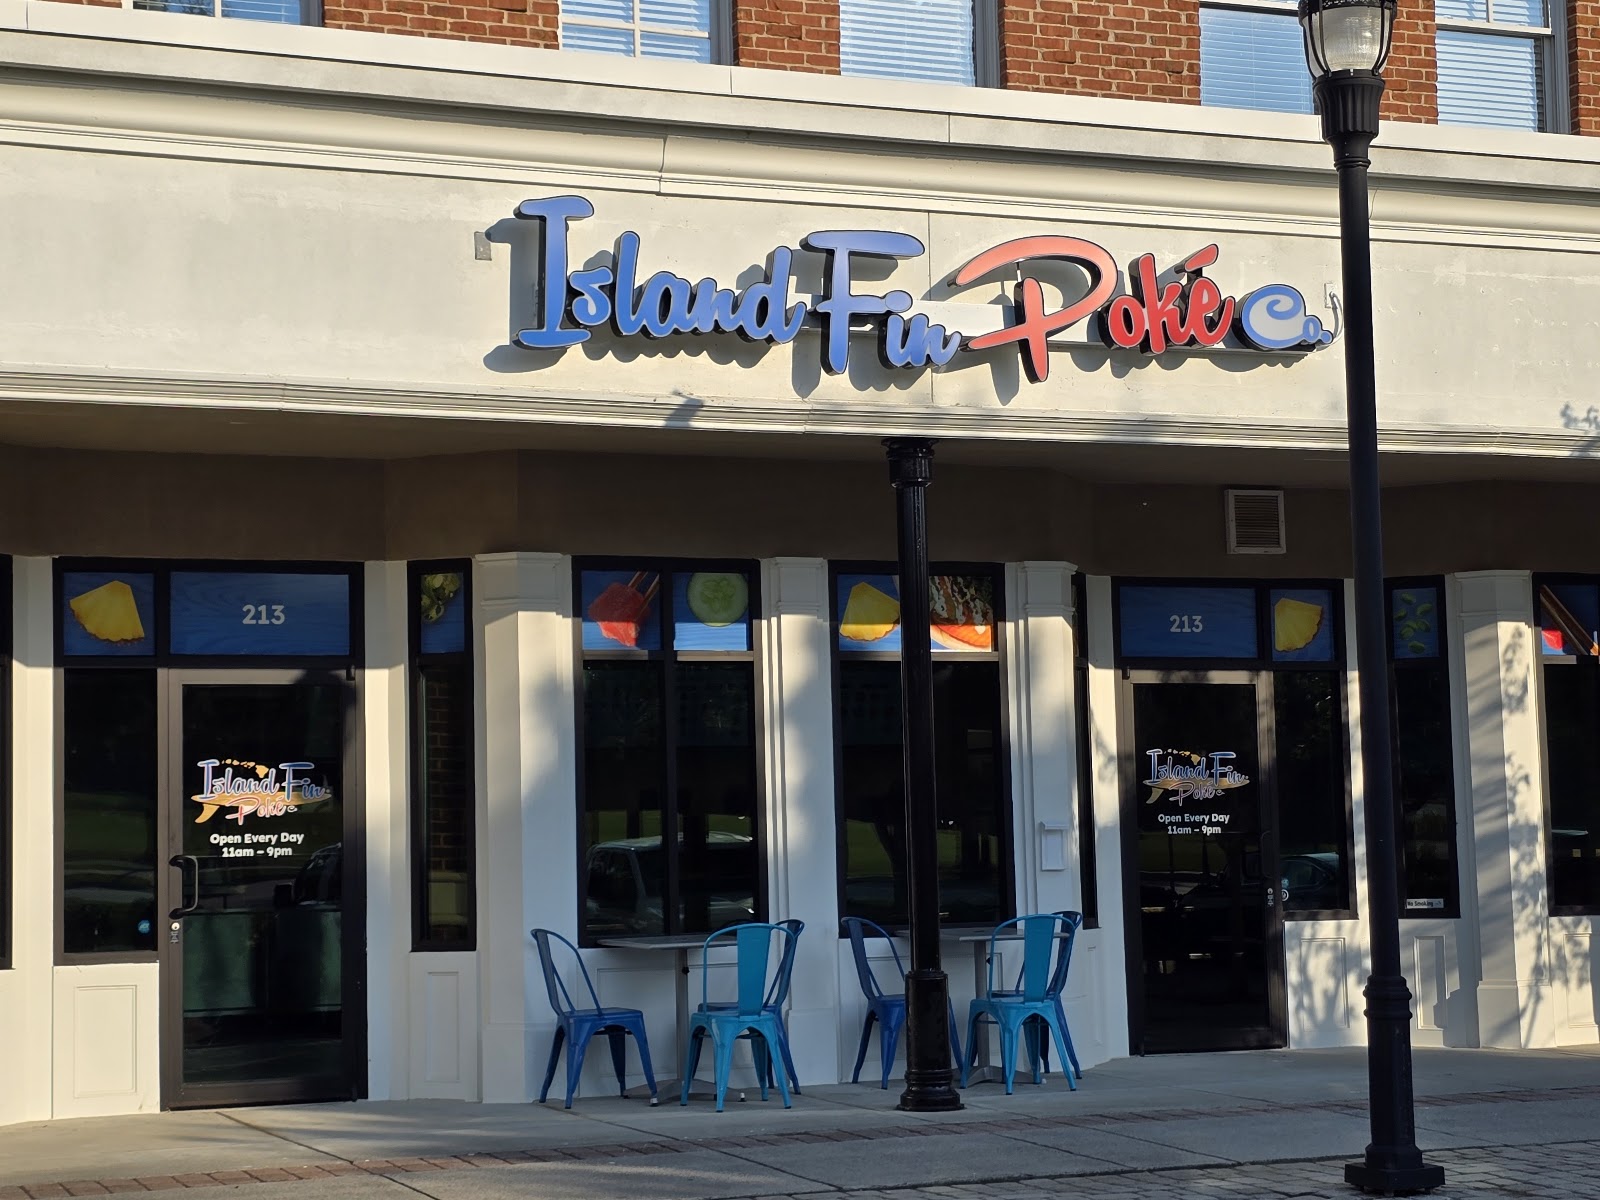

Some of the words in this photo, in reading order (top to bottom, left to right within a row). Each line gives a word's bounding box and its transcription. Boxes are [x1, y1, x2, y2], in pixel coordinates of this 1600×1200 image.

[512, 195, 805, 347] Island
[800, 230, 962, 375] Fin
[947, 235, 1235, 383] Poké
[1235, 283, 1335, 351] Co.
[242, 604, 286, 625] 213
[1169, 614, 1203, 633] 213
[1146, 749, 1209, 784] Island
[1208, 752, 1246, 786] Fin
[197, 759, 280, 800] Island
[279, 762, 325, 801] Fin
[1168, 781, 1216, 806] Poké
[225, 796, 286, 825] Poké
[1157, 813, 1182, 824] Open
[1184, 813, 1210, 824] Every
[1211, 813, 1230, 824] Day
[209, 834, 242, 846] Open
[244, 833, 278, 845] Every
[280, 832, 304, 844] Day
[1167, 825, 1192, 835] 11am
[1201, 825, 1222, 836] 9pm
[221, 847, 254, 858] 11am
[266, 846, 293, 858] 9pm
